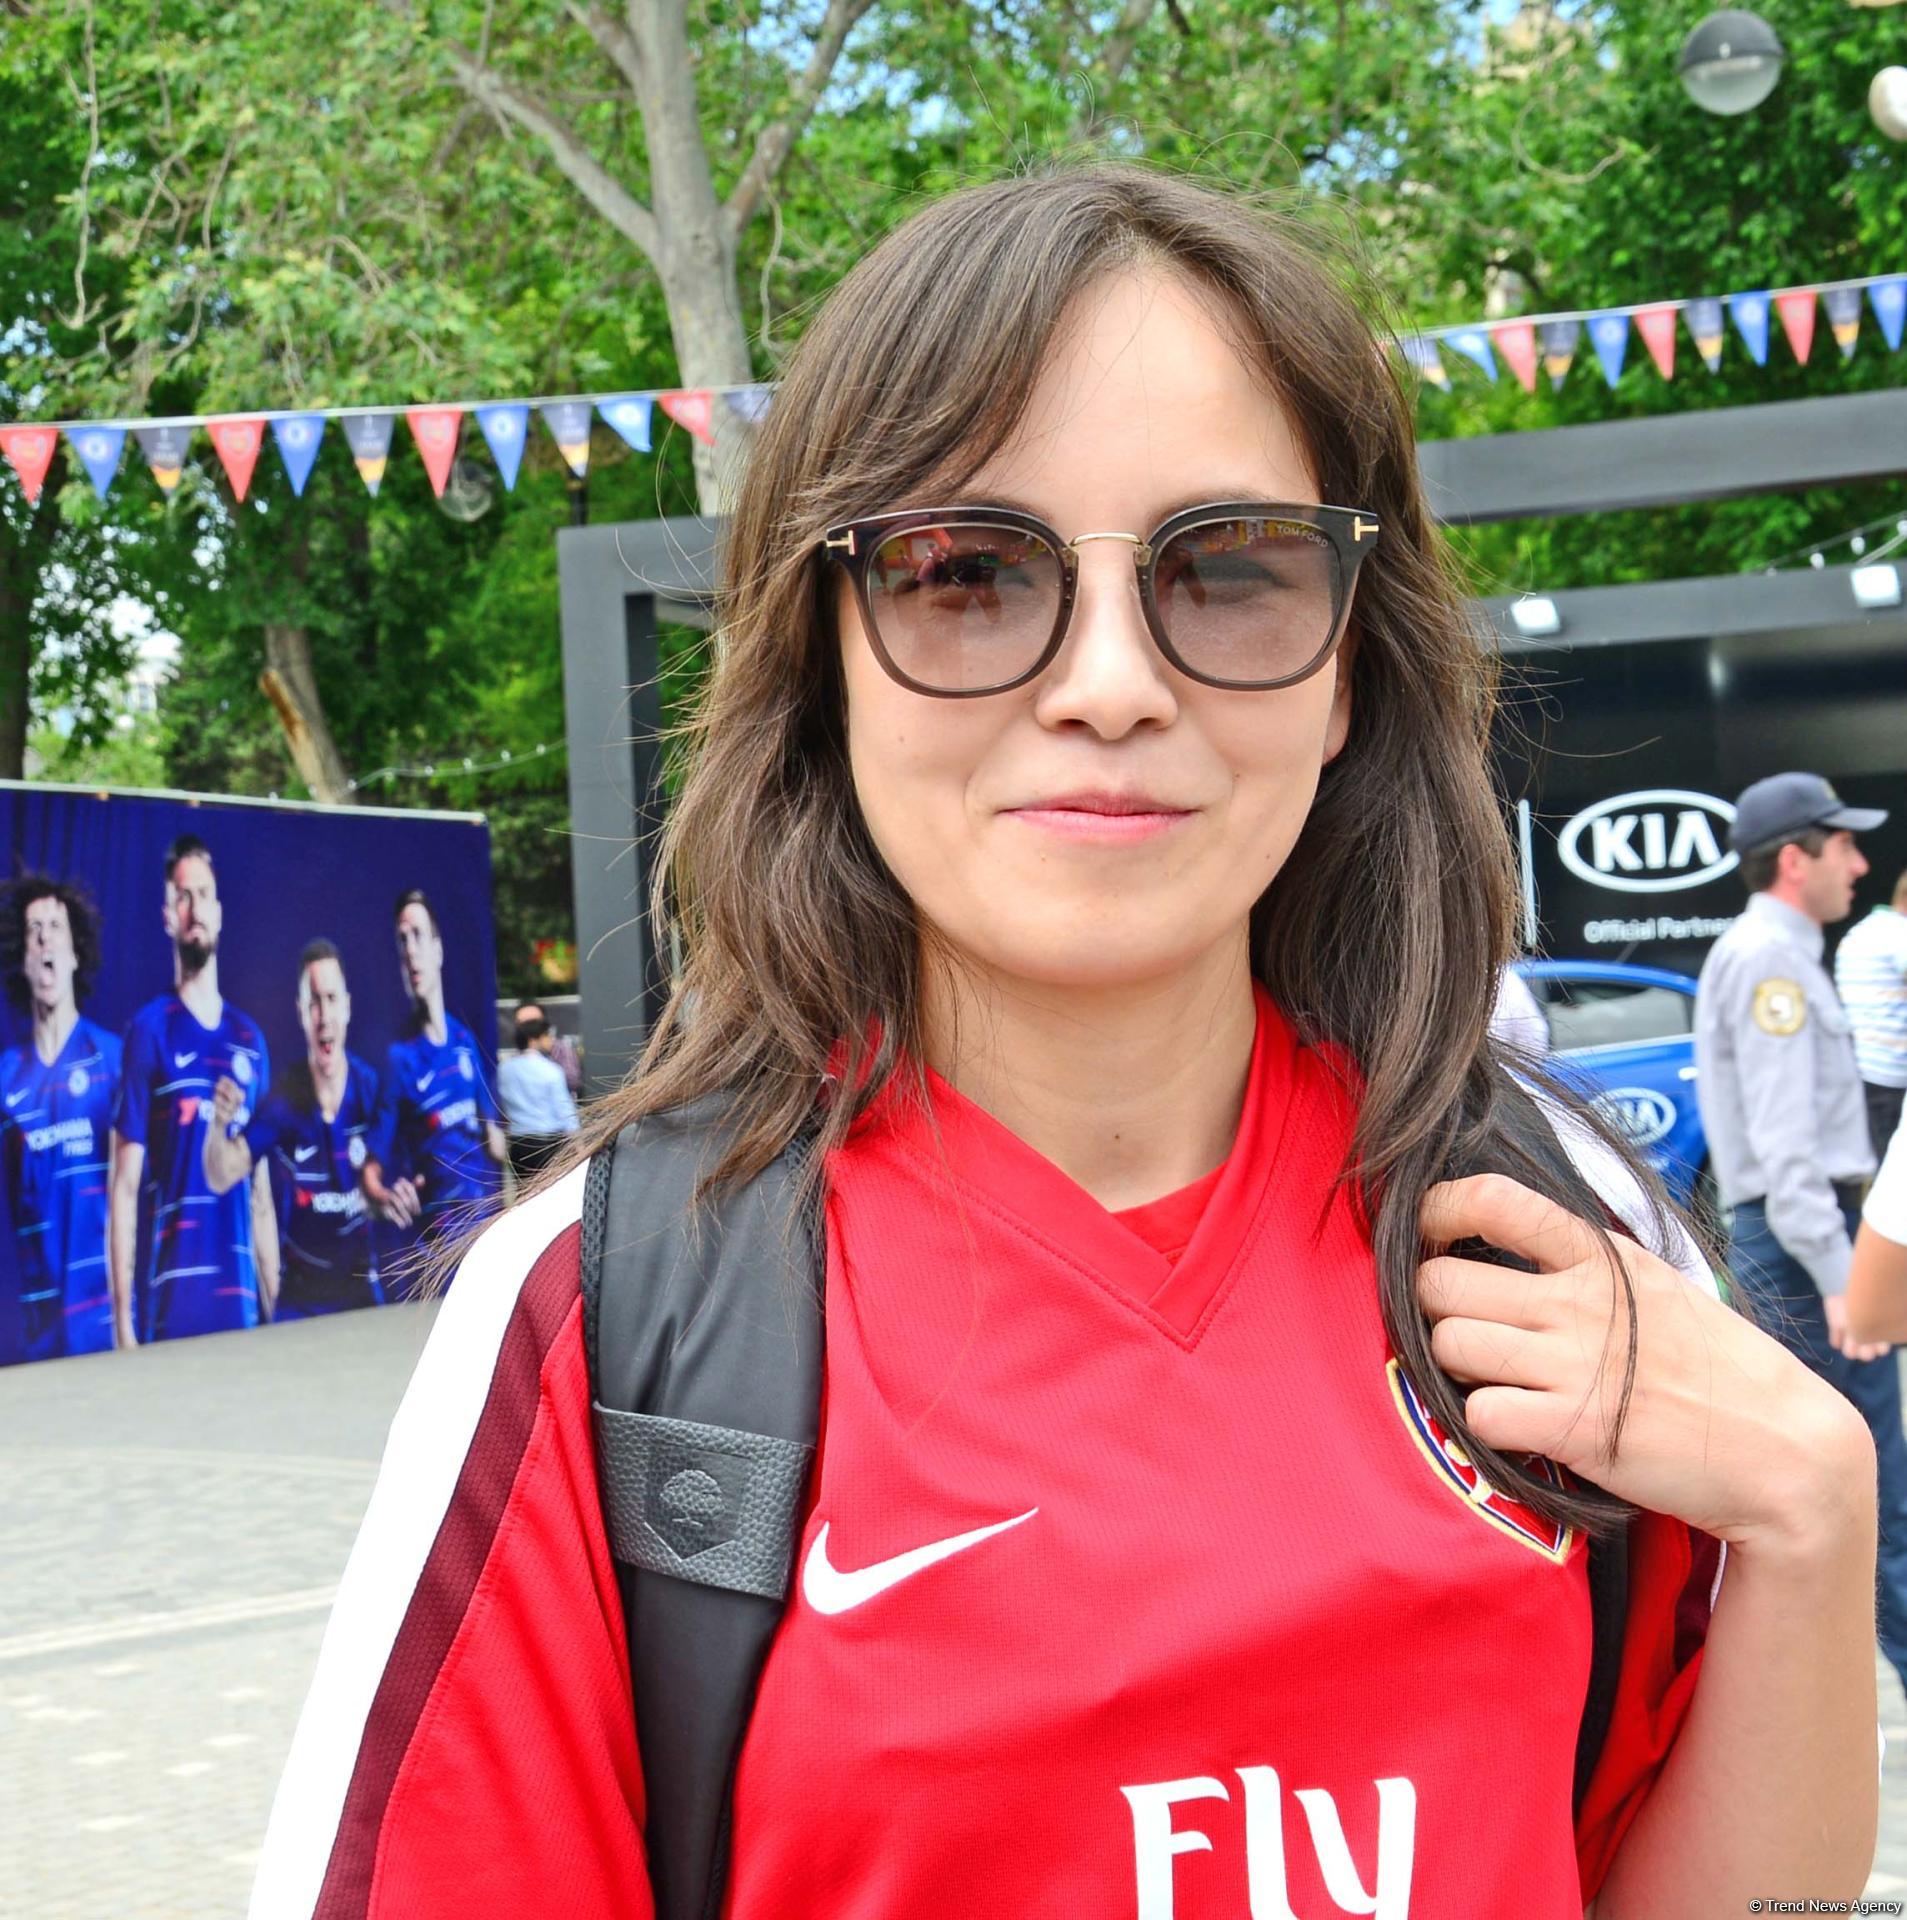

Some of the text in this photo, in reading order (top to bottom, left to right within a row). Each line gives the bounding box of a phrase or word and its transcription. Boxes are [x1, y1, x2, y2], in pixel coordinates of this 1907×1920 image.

[1277, 525, 1329, 548] TOM FORD
[1592, 810, 1722, 872] KIA
[1583, 919, 1656, 944] Official
[1119, 1765, 1417, 1920] Fly
